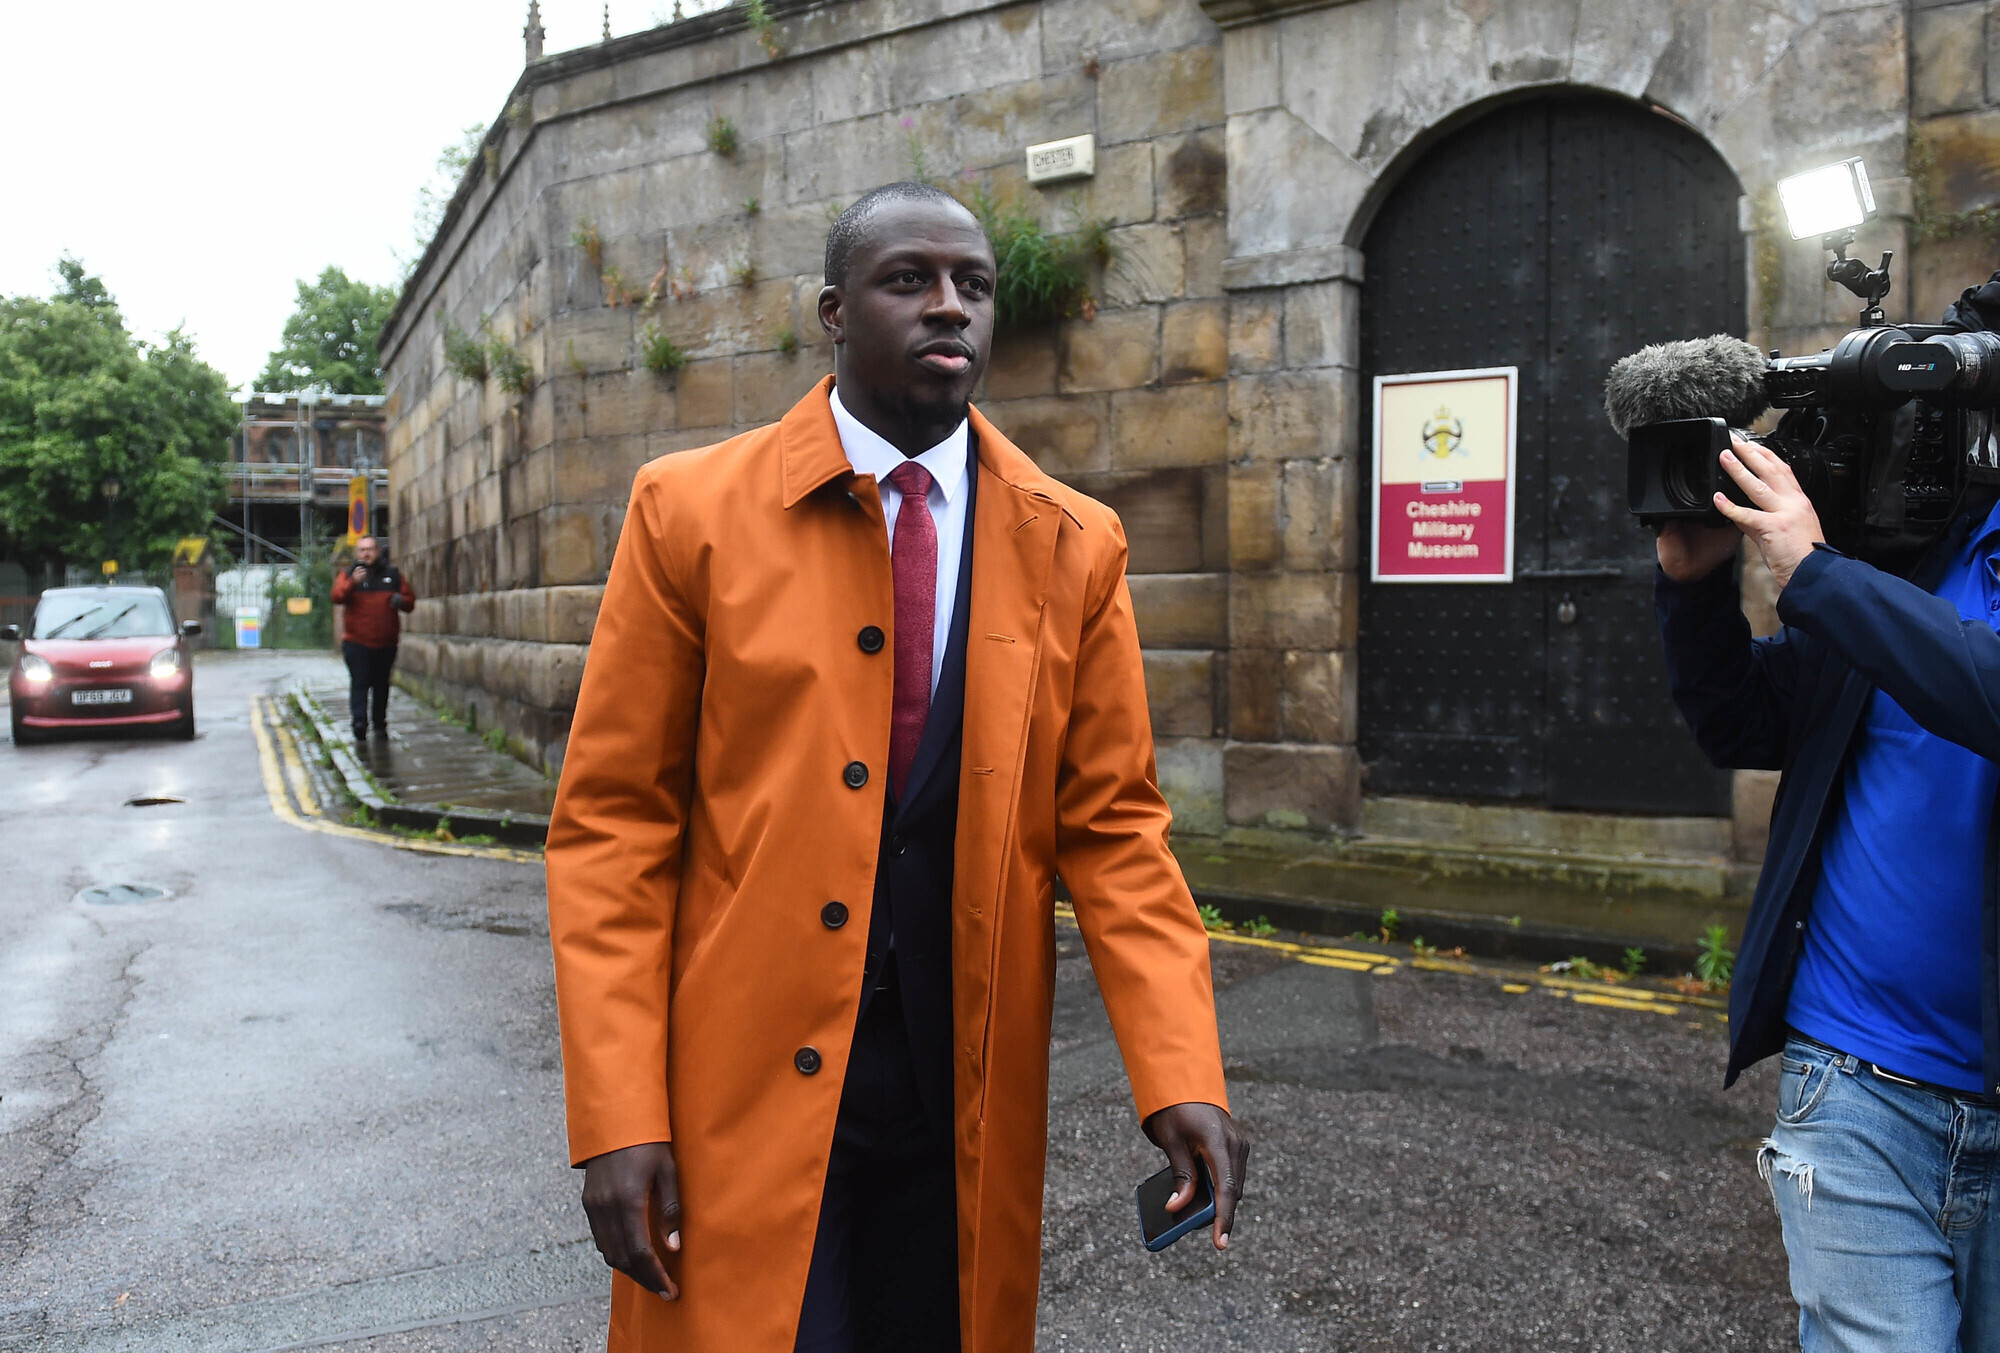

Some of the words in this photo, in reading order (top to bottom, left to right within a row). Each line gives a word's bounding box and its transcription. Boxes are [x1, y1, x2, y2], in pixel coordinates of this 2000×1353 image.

[1406, 500, 1482, 518] Cheshire
[1412, 521, 1475, 541] Military
[1407, 541, 1479, 559] Museum
